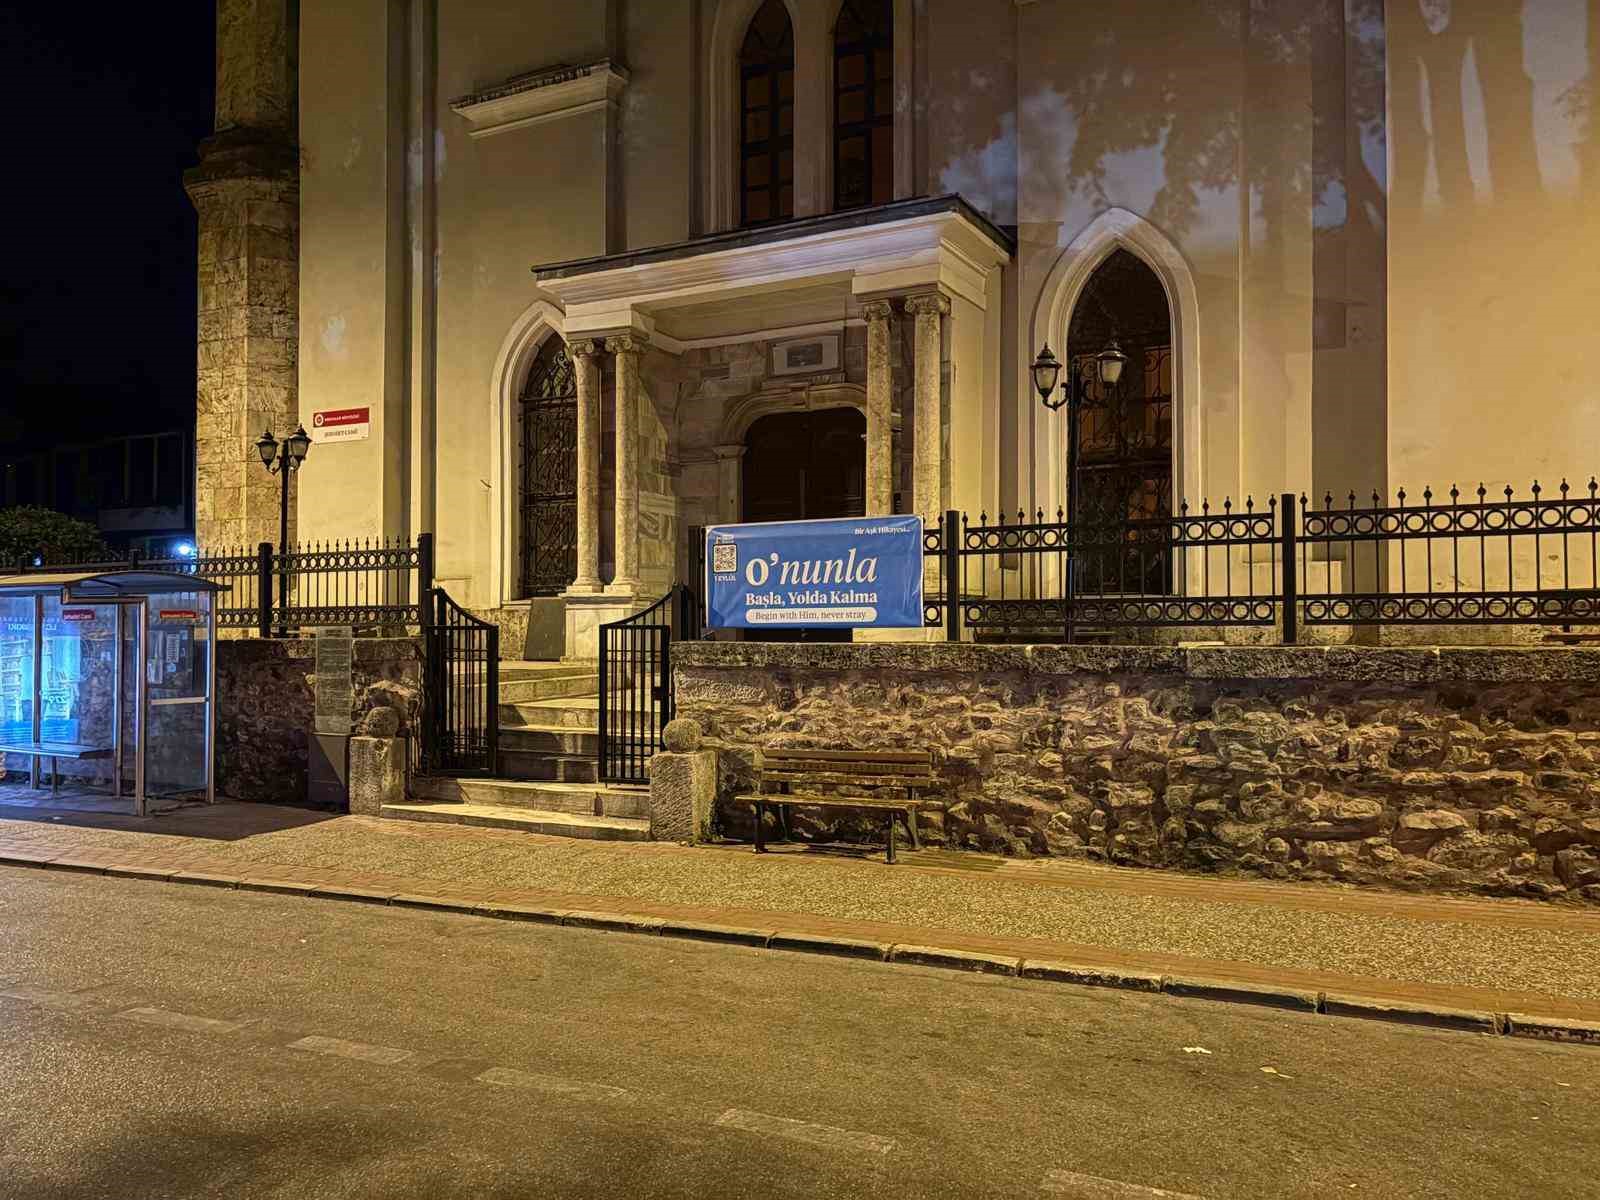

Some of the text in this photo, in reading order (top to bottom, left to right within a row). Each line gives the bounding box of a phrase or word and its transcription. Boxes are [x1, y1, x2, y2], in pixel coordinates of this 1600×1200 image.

[745, 589, 878, 608] Başla, Yolda Kalma
[755, 608, 866, 621] Begin with Him, never stray
